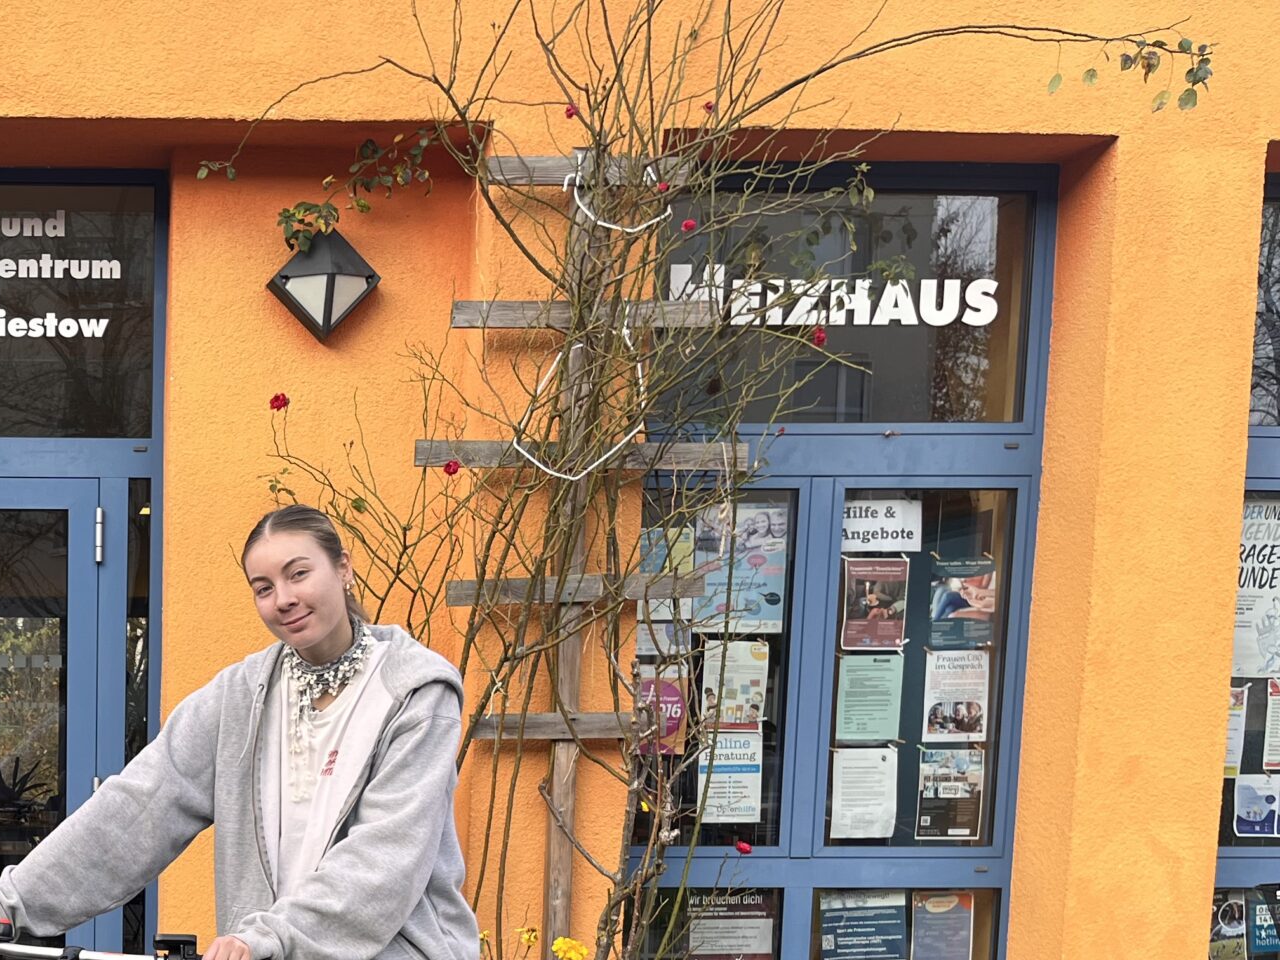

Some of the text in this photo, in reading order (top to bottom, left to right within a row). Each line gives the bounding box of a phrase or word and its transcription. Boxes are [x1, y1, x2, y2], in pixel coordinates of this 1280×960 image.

[0, 209, 67, 238] und
[842, 505, 896, 519] Hilfe &
[841, 527, 914, 544] Angebote
